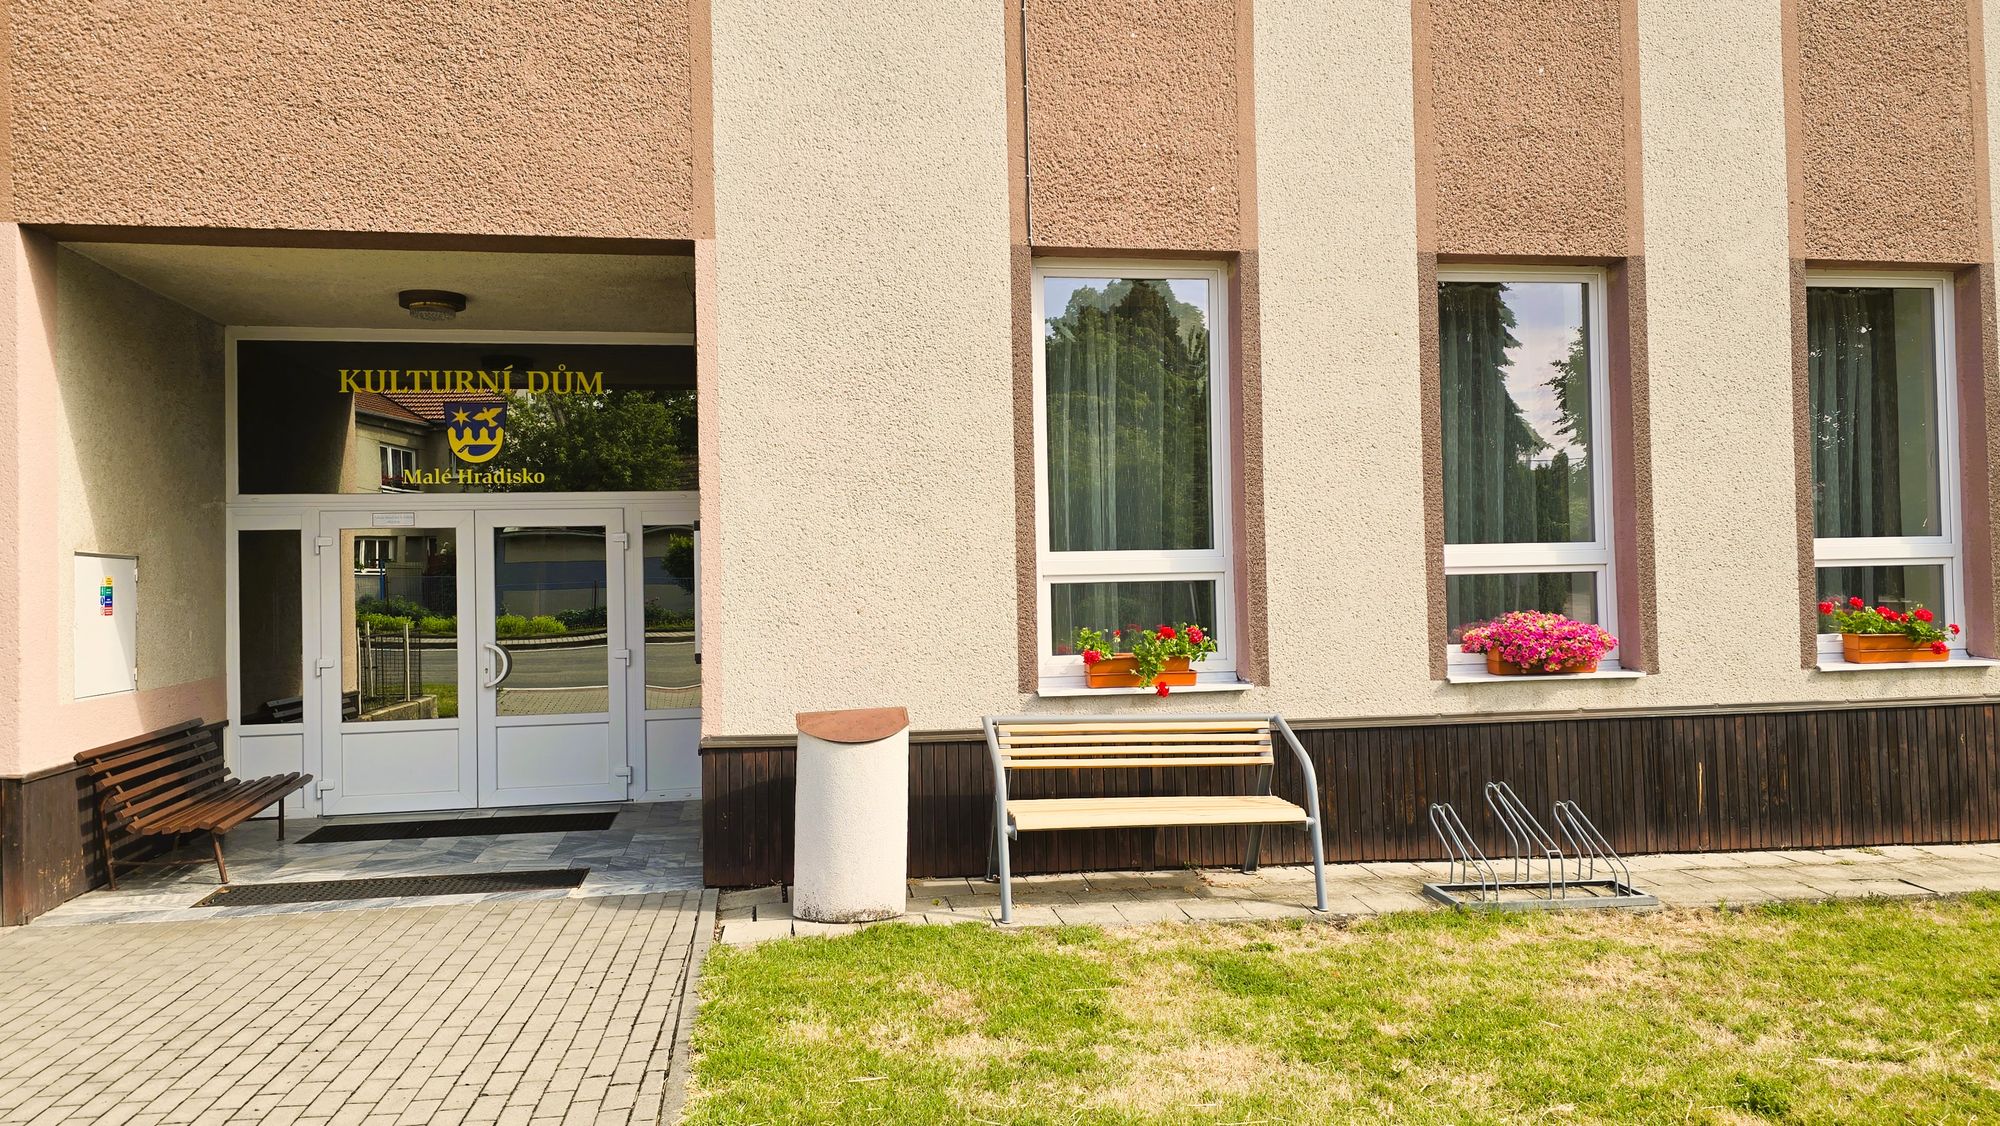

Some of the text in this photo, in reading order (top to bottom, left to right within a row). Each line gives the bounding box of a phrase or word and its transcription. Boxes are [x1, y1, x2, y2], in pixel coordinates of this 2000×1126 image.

[338, 364, 604, 395] KULTURNÍ DŮM
[402, 468, 545, 485] Malé Hradisko
